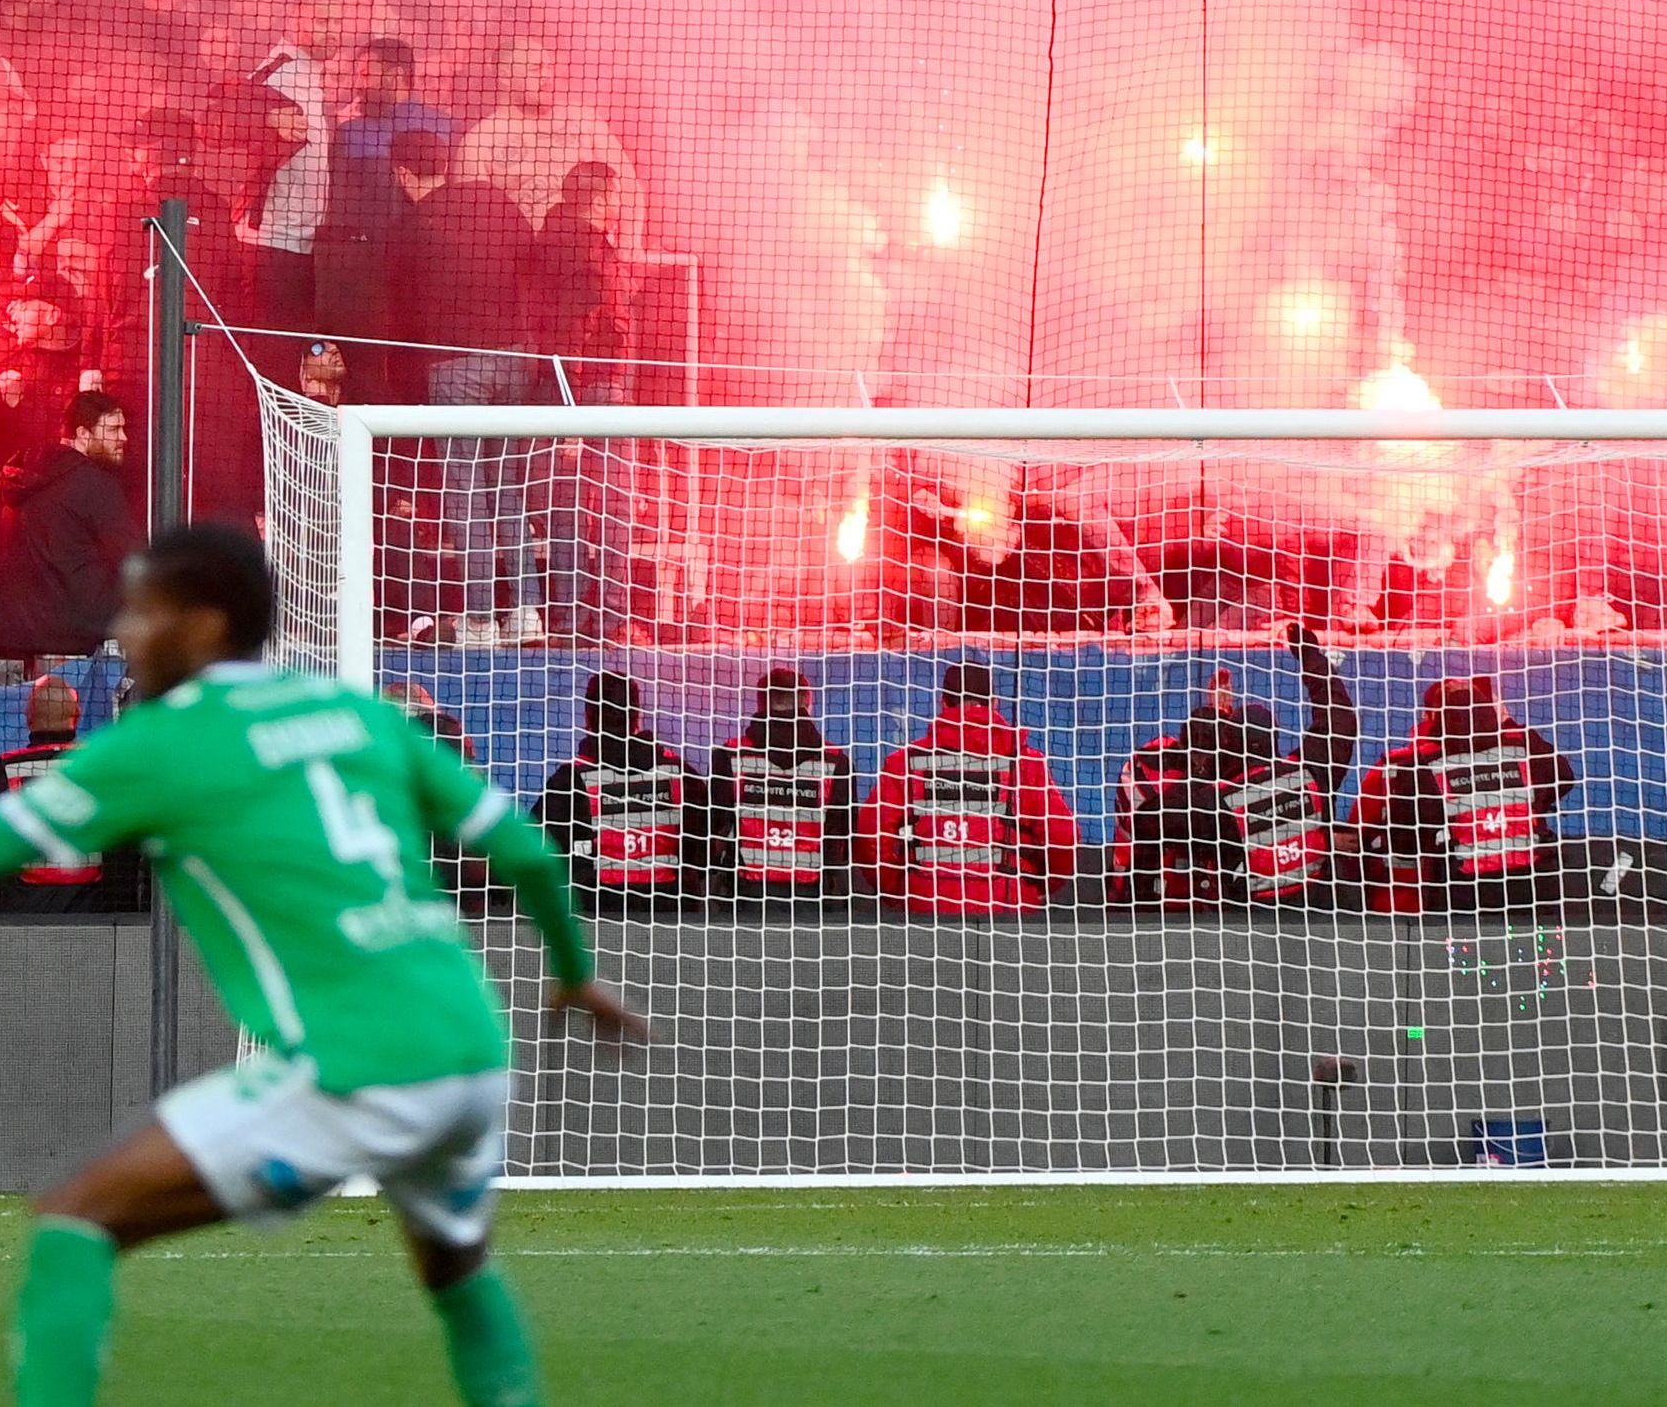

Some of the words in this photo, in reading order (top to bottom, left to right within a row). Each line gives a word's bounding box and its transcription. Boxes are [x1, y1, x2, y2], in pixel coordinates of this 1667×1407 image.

[767, 827, 793, 848] 32
[942, 819, 969, 841] 81
[623, 833, 648, 853] 61
